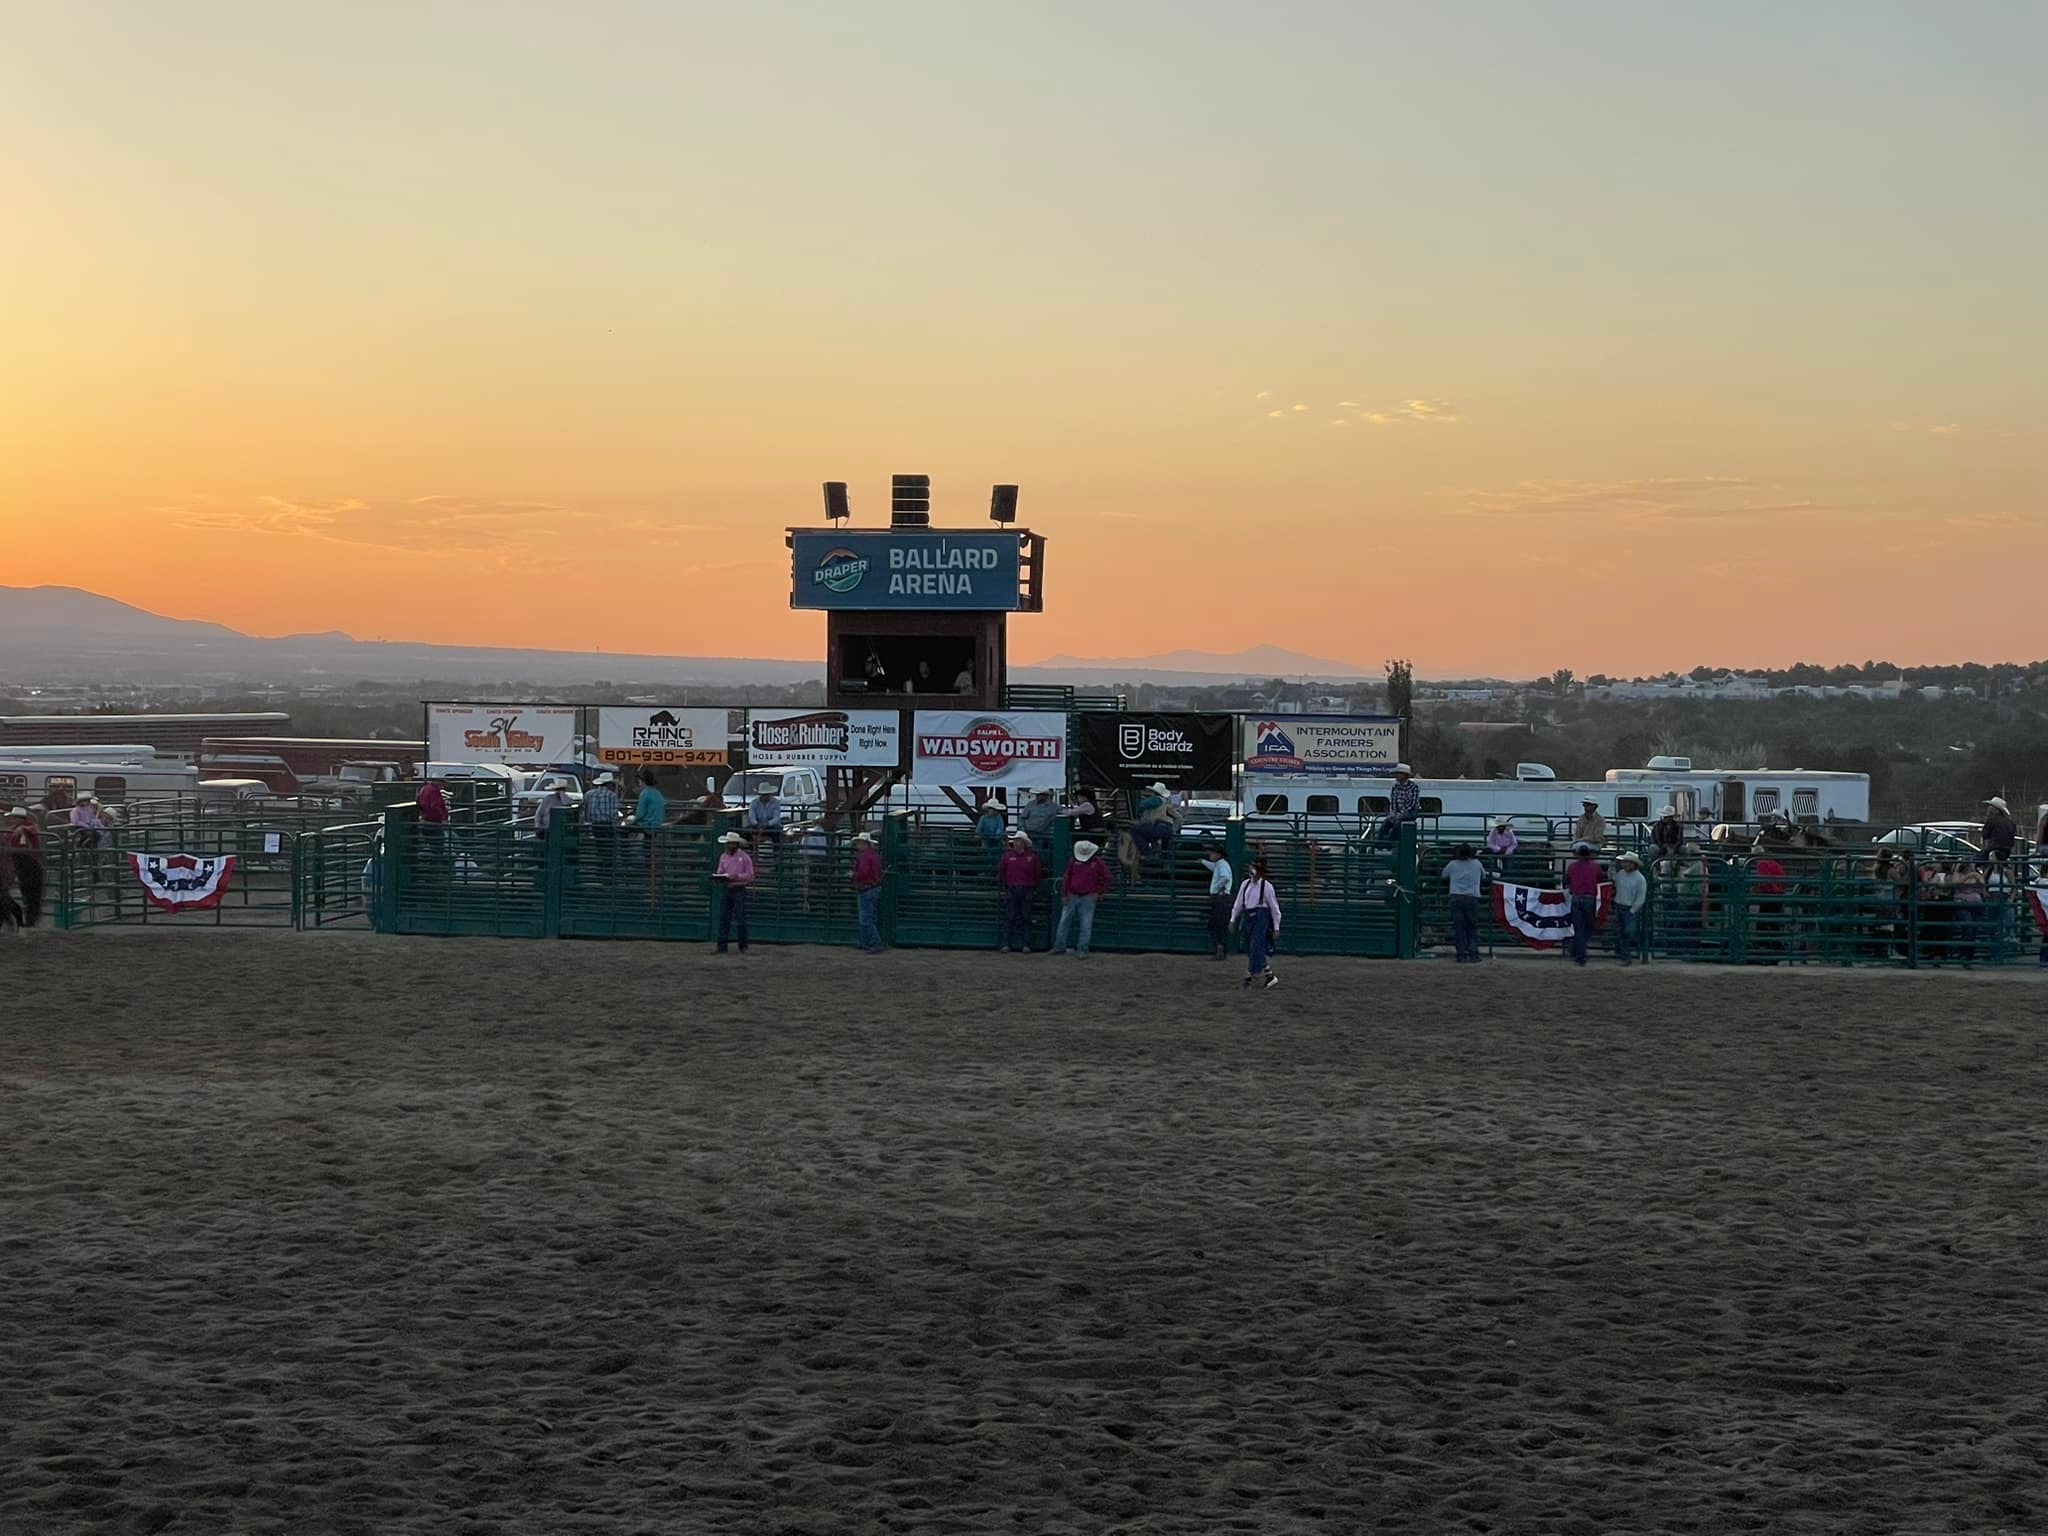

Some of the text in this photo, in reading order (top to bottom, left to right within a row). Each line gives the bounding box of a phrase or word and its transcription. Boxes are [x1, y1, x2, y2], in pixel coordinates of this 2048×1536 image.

[890, 548, 998, 569] BALLARD
[815, 559, 868, 583] DRAPER
[889, 574, 972, 594] ARENA
[633, 727, 693, 739] RHINO
[850, 724, 866, 734] Done
[867, 724, 882, 736] Right
[1148, 729, 1184, 742] Body
[1296, 727, 1395, 737] INTERMOUNTAIN
[633, 740, 693, 748] RENTALS
[859, 738, 874, 749] Right
[922, 738, 1057, 757] WADSWORTH
[1148, 740, 1193, 752] Guardz
[1264, 744, 1291, 753] IFA
[1317, 738, 1374, 747] FARMERS
[605, 750, 722, 762] 801-930-9471
[1304, 749, 1387, 759] ASSOCIATION
